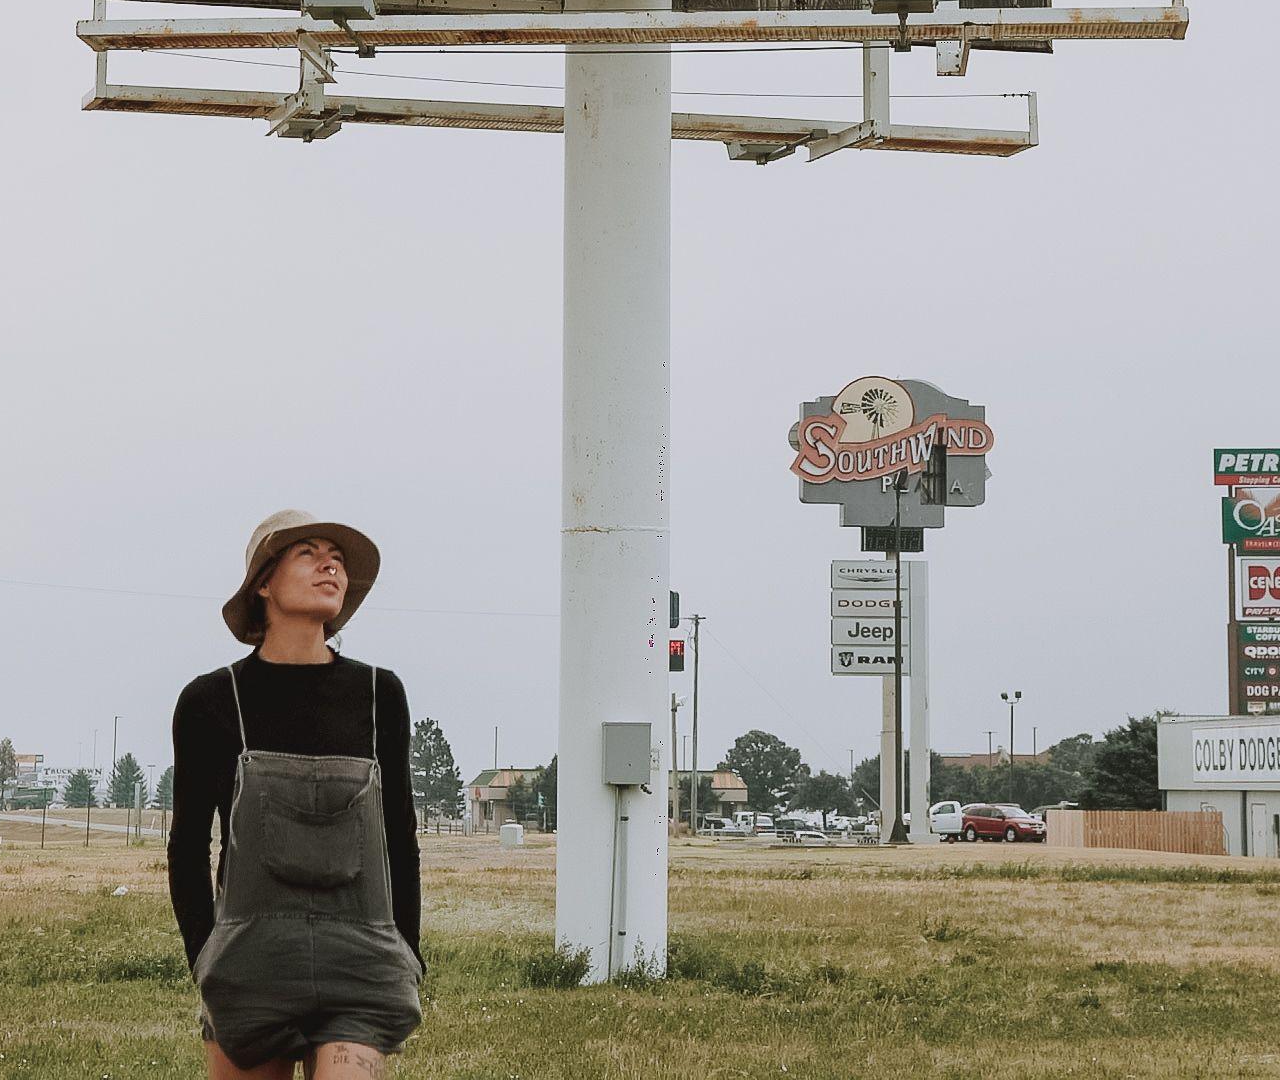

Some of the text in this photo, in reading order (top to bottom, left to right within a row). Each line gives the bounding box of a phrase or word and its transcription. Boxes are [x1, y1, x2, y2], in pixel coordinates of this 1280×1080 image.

[798, 422, 987, 476] SOUTHWND
[848, 622, 894, 641] Jeep
[1246, 685, 1270, 696] DOG
[1195, 739, 1233, 771] COLBY
[43, 767, 73, 775] TRUCK
